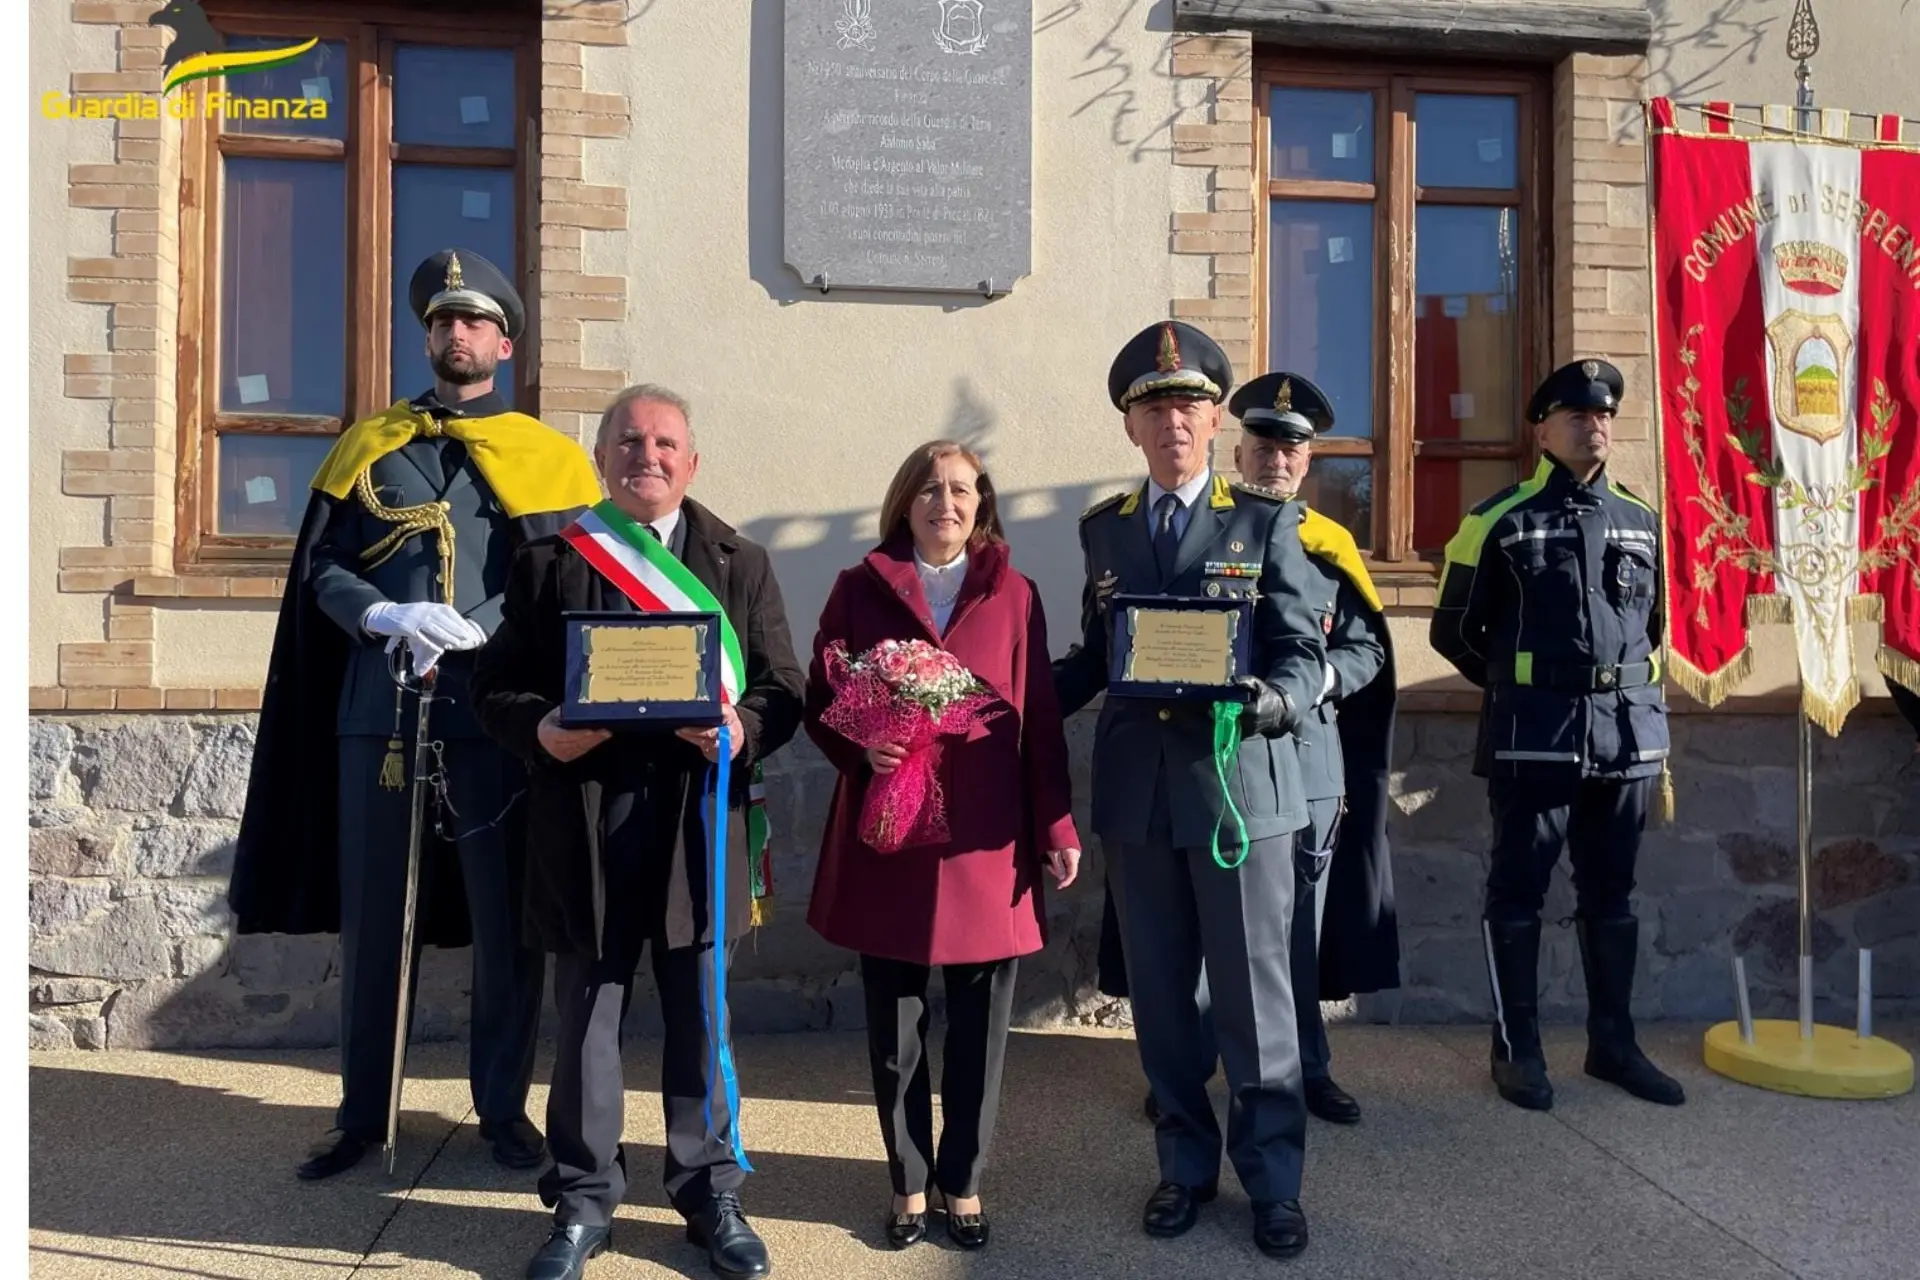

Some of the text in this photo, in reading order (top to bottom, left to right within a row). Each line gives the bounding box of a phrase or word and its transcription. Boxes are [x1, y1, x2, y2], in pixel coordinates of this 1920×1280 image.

[880, 134, 914, 150] Antonio
[832, 156, 871, 173] Medaglia
[1684, 182, 1920, 289] COMUNE DI SERREN
